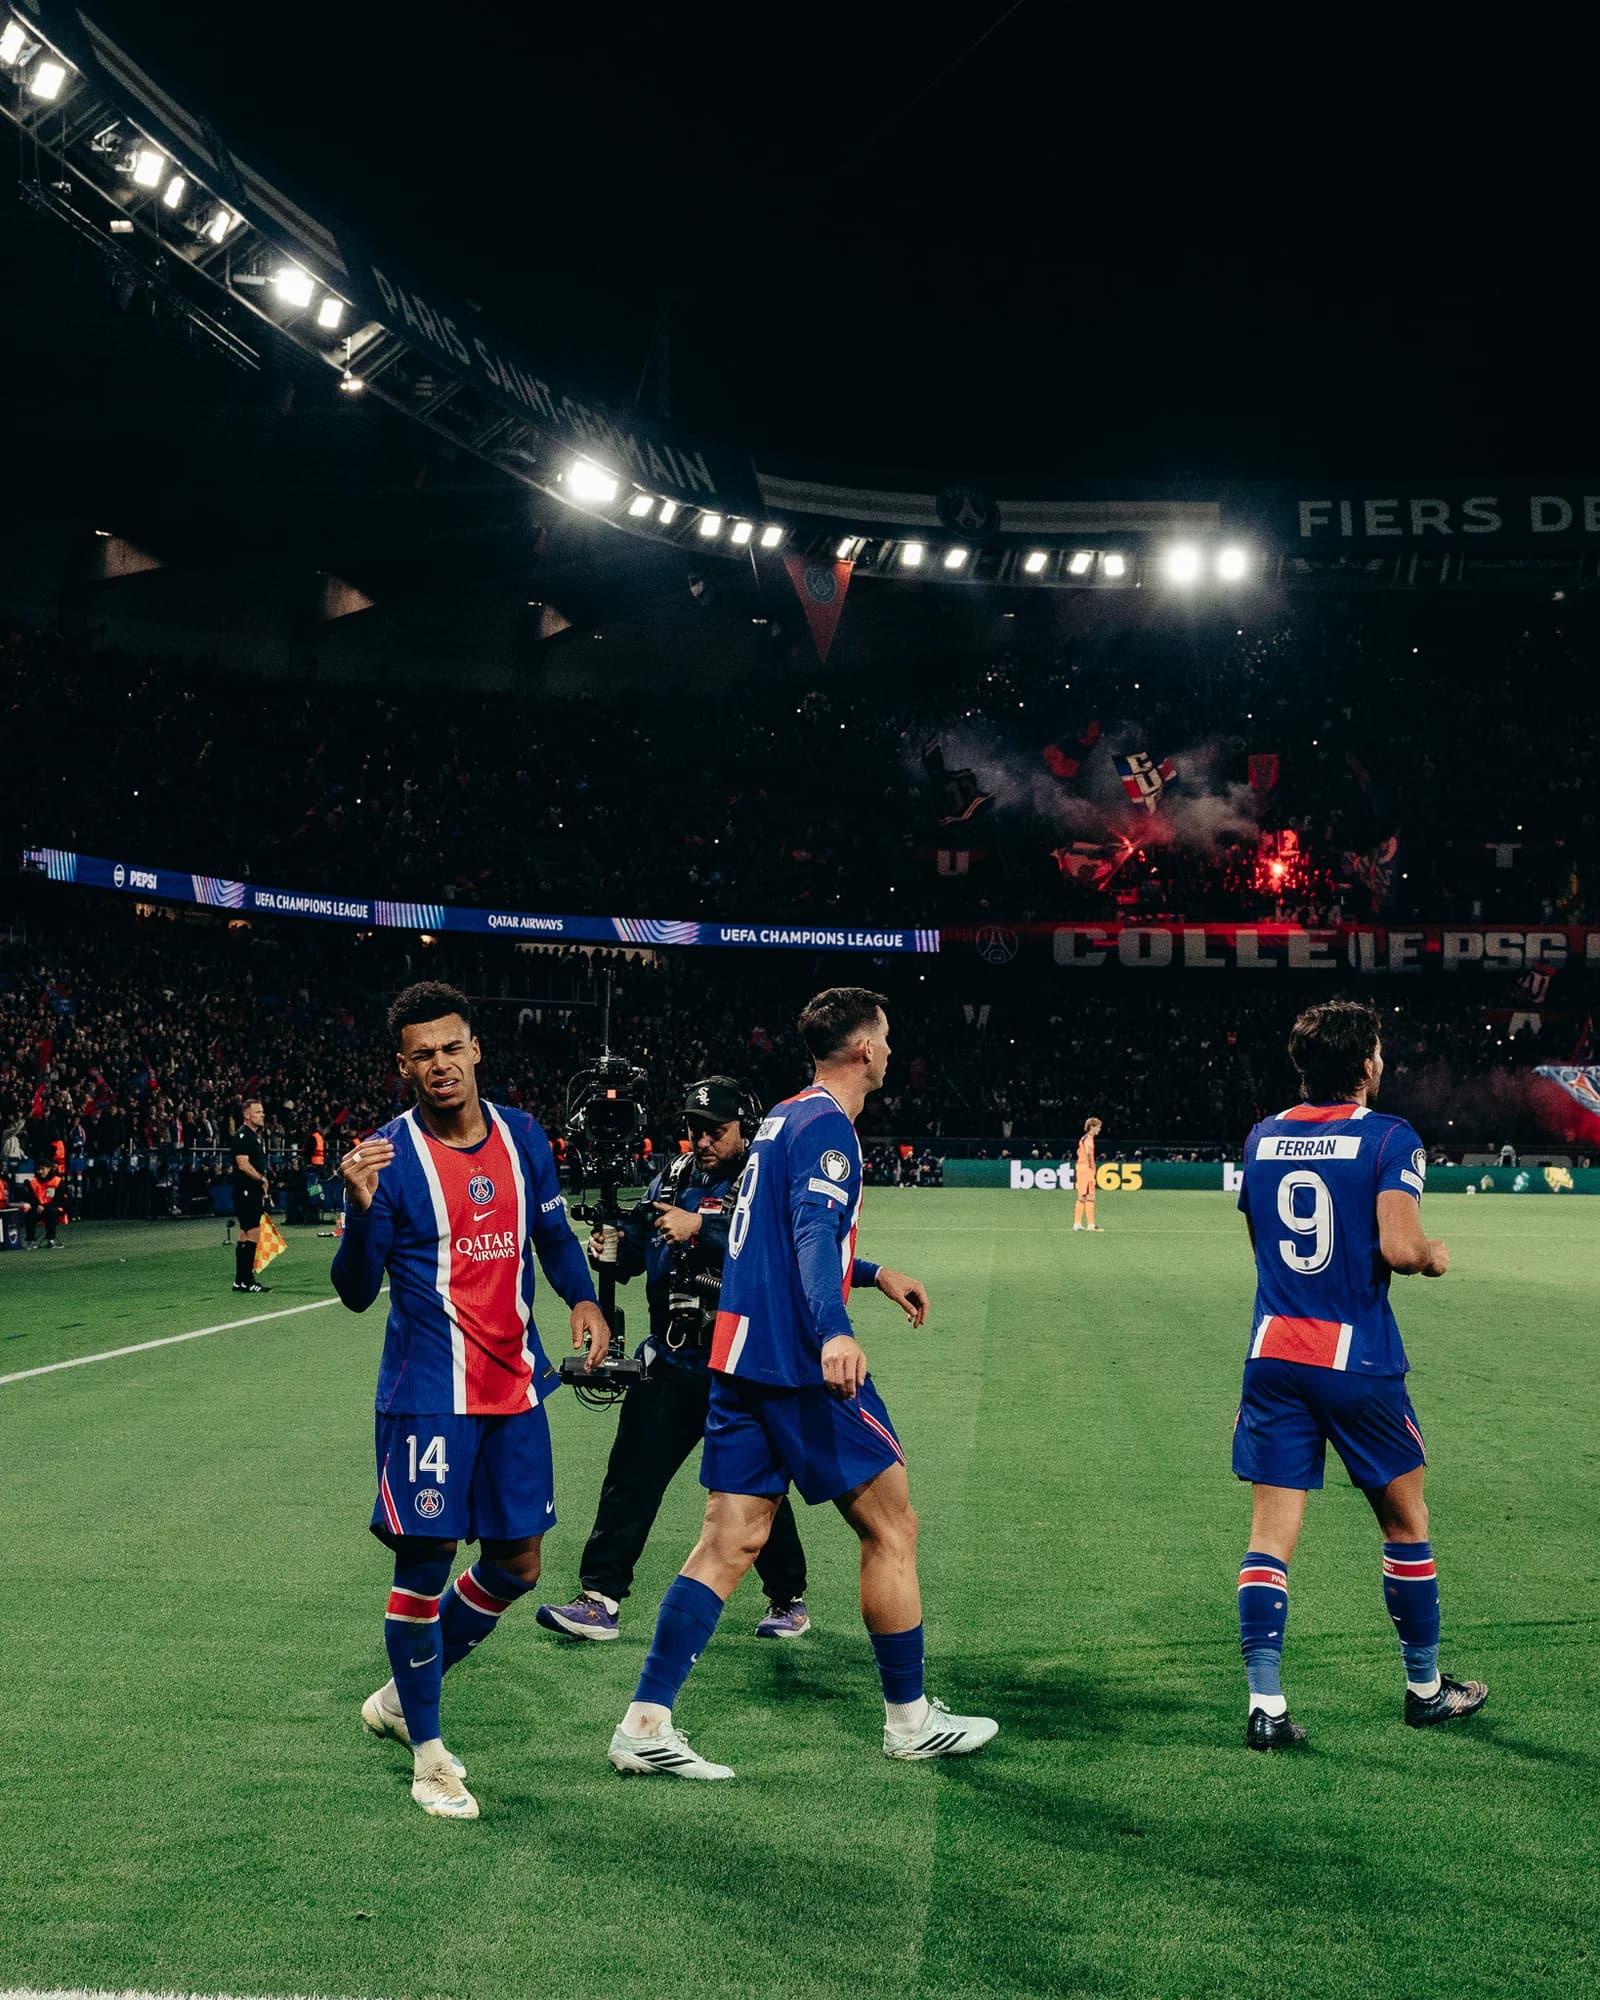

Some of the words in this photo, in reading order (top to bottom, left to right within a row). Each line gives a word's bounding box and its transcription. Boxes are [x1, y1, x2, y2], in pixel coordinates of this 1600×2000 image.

[371, 264, 471, 365] PARIS
[1299, 496, 1503, 537] FIERS
[130, 869, 158, 890] PEPSI
[255, 891, 275, 908] UEFA
[276, 894, 332, 915] CHAMPIONS
[333, 902, 369, 918] LEAGUE
[488, 914, 519, 929] QATAR
[520, 917, 564, 931] AIRWAYS
[720, 928, 757, 942] UEFA
[760, 930, 845, 945] CHAMPIONS
[848, 933, 903, 947] LEAGUE
[1053, 927, 1357, 969] COLLE
[1442, 931, 1568, 972] PSG
[1275, 1139, 1336, 1156] FERRAN
[1010, 1160, 1143, 1191] bet65
[728, 1151, 760, 1260] 8
[1277, 1169, 1334, 1275] 9
[455, 1231, 515, 1257] QATAR
[471, 1247, 516, 1262] AIRWAYS
[406, 1435, 449, 1484] 14
